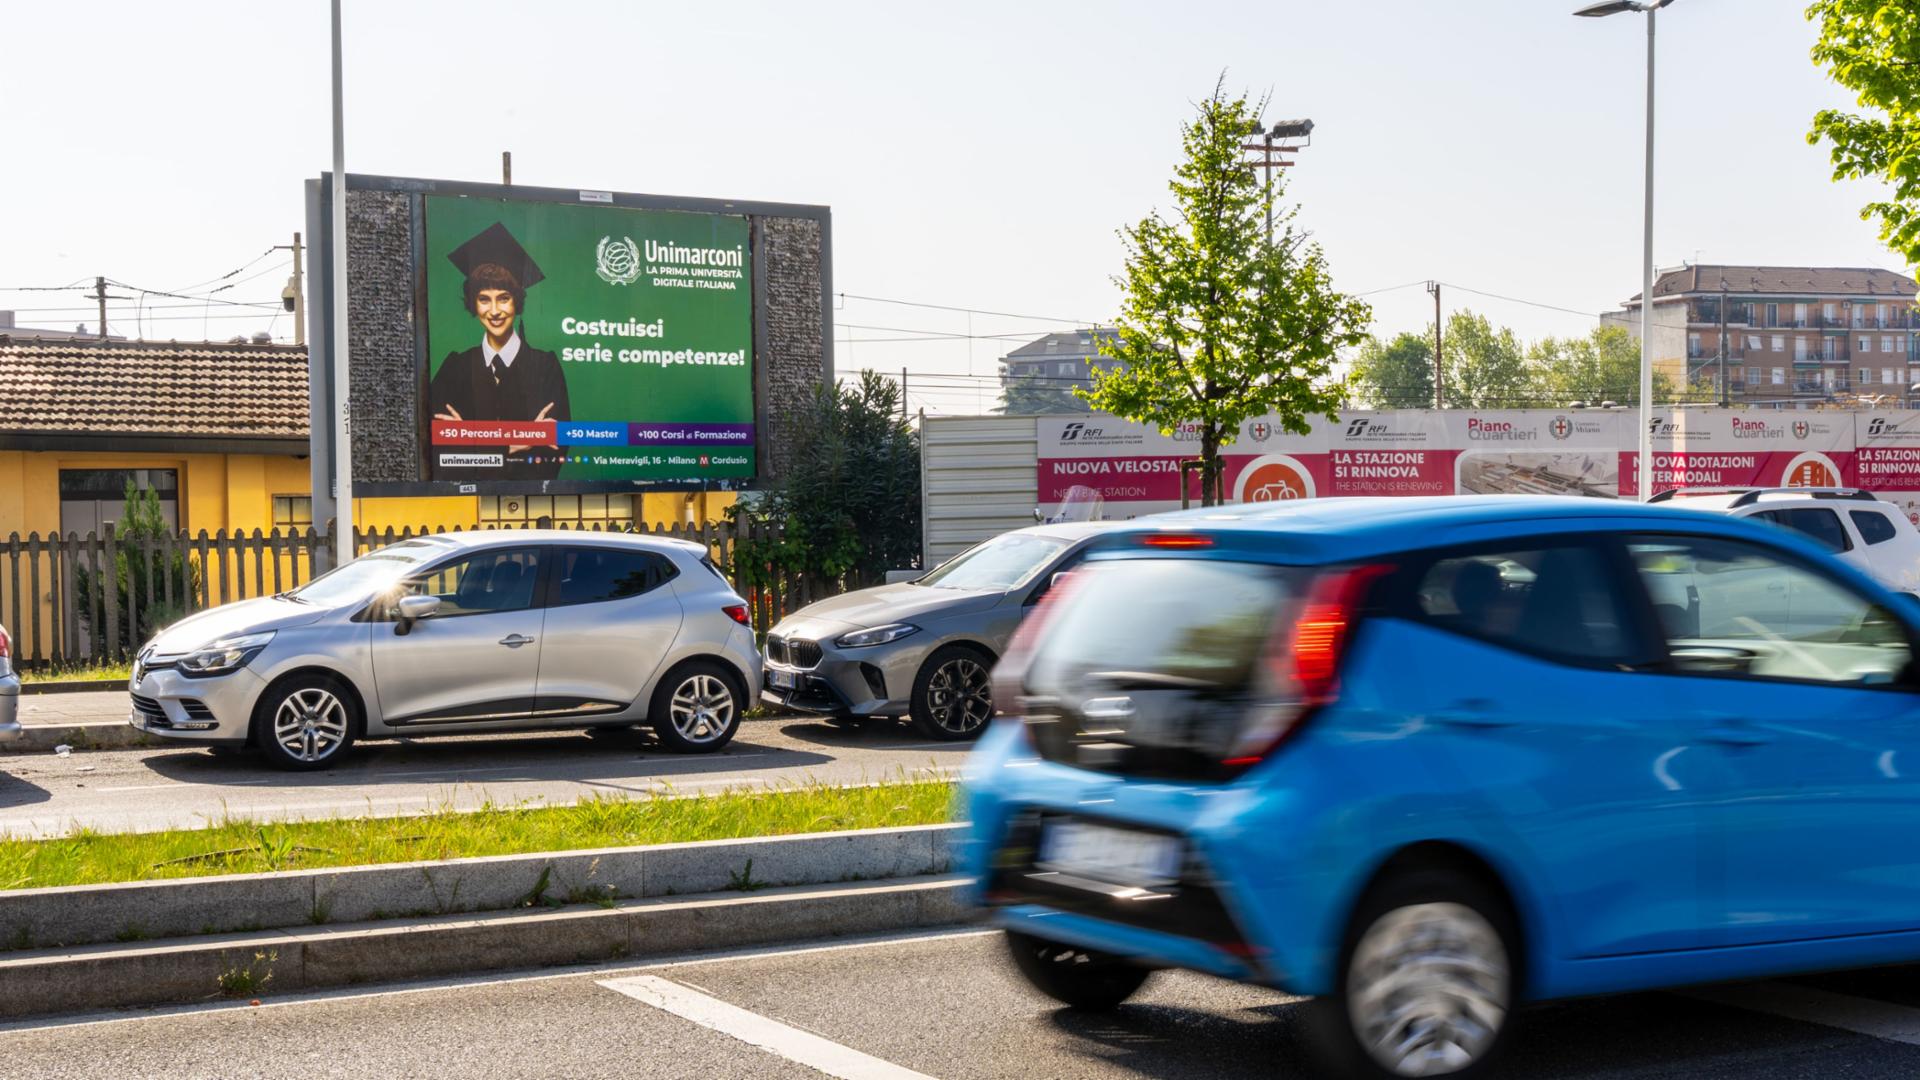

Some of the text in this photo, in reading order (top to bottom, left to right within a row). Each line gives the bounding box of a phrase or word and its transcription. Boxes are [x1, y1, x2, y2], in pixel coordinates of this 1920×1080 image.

[645, 240, 742, 267] Unimarconi
[646, 266, 742, 278] LA PRIMA UNIVERSITÀ
[653, 279, 736, 290] DIGITALE ITALIANA
[561, 317, 664, 338] Costruisci
[561, 342, 745, 367] serie competenze!
[1368, 425, 1387, 433] RFI
[1468, 418, 1512, 432] Piano
[1732, 418, 1765, 430] Piano
[439, 429, 457, 438] +50
[460, 428, 502, 439] Percorsi
[513, 430, 546, 438] Laurea
[566, 430, 619, 439] +50 Master
[638, 431, 659, 439] +100
[661, 430, 685, 439] Corsi
[694, 431, 747, 440] Formazione
[1468, 428, 1537, 441] Quartieri
[1733, 426, 1784, 439] Quartieri
[441, 455, 501, 466] unimarconi.it
[1335, 453, 1424, 464] LA STAZIONE
[1859, 450, 1920, 460] LA STAZION
[593, 456, 608, 465] Via
[609, 456, 651, 467] Meravigli,
[652, 457, 661, 465] 16
[668, 456, 697, 465] Milano
[711, 456, 748, 465] Cordusio
[1633, 456, 1755, 468] NOVA DOTAZIONI
[1053, 462, 1110, 474] NUOVA
[1335, 466, 1419, 478] SI RINNOVA
[1859, 462, 1920, 473] SI RINNOVA
[1633, 471, 1721, 483] ITERMODALI
[1105, 486, 1146, 496] STATION
[1336, 481, 1443, 491] THE STATION IS RENEWING
